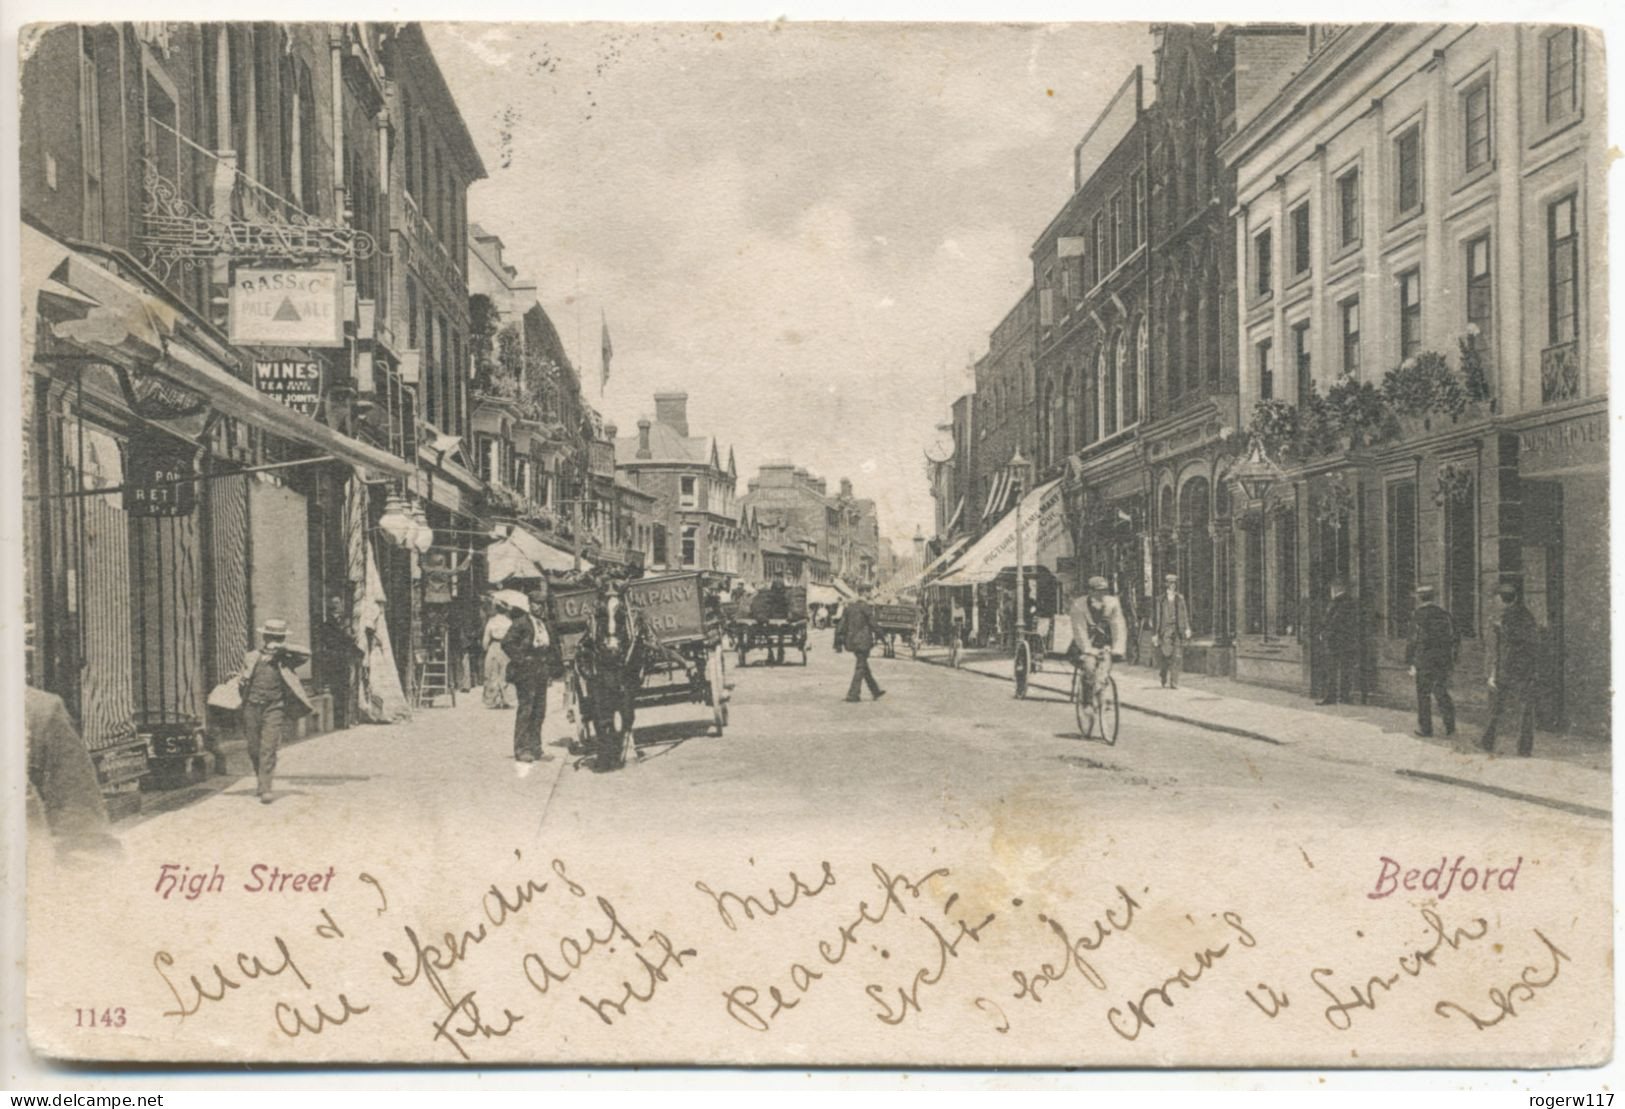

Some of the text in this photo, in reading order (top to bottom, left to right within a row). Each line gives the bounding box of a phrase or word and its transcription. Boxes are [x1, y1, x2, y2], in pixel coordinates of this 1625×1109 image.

[192, 221, 352, 251] BARNES
[241, 273, 297, 294] BASS
[240, 301, 332, 317] PALE ALE
[256, 362, 319, 379] WINES
[260, 381, 283, 390] TEA
[154, 863, 336, 900] High Street
[1367, 855, 1524, 900] Bedford
[275, 848, 586, 1038] are spending
[522, 895, 641, 994] day
[578, 856, 836, 1025] with Miss
[1106, 910, 1257, 1042] coming
[75, 1006, 127, 1028] 1143
